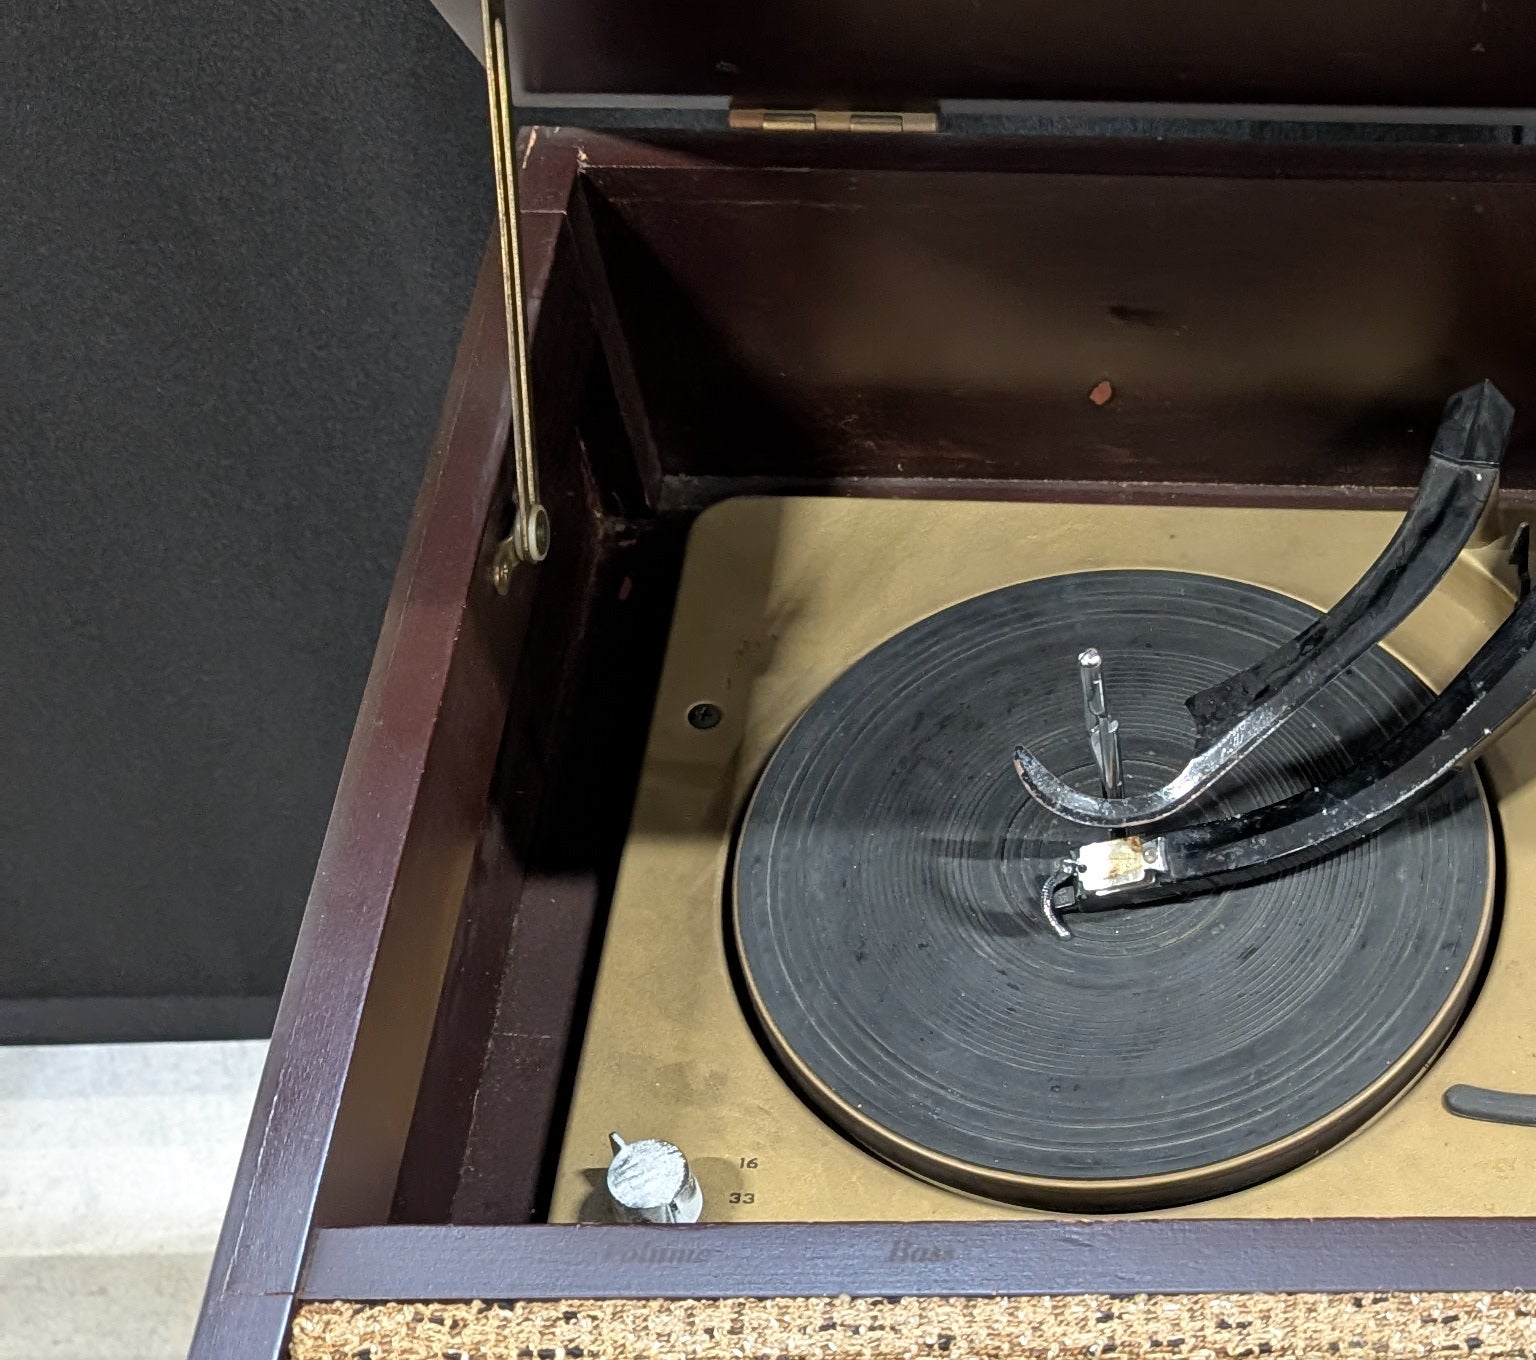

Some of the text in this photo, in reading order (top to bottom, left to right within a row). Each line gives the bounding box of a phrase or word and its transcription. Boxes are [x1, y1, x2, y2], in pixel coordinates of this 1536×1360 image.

[740, 1157, 759, 1169] 16
[728, 1192, 755, 1204] 33
[888, 1238, 955, 1264] Bass
